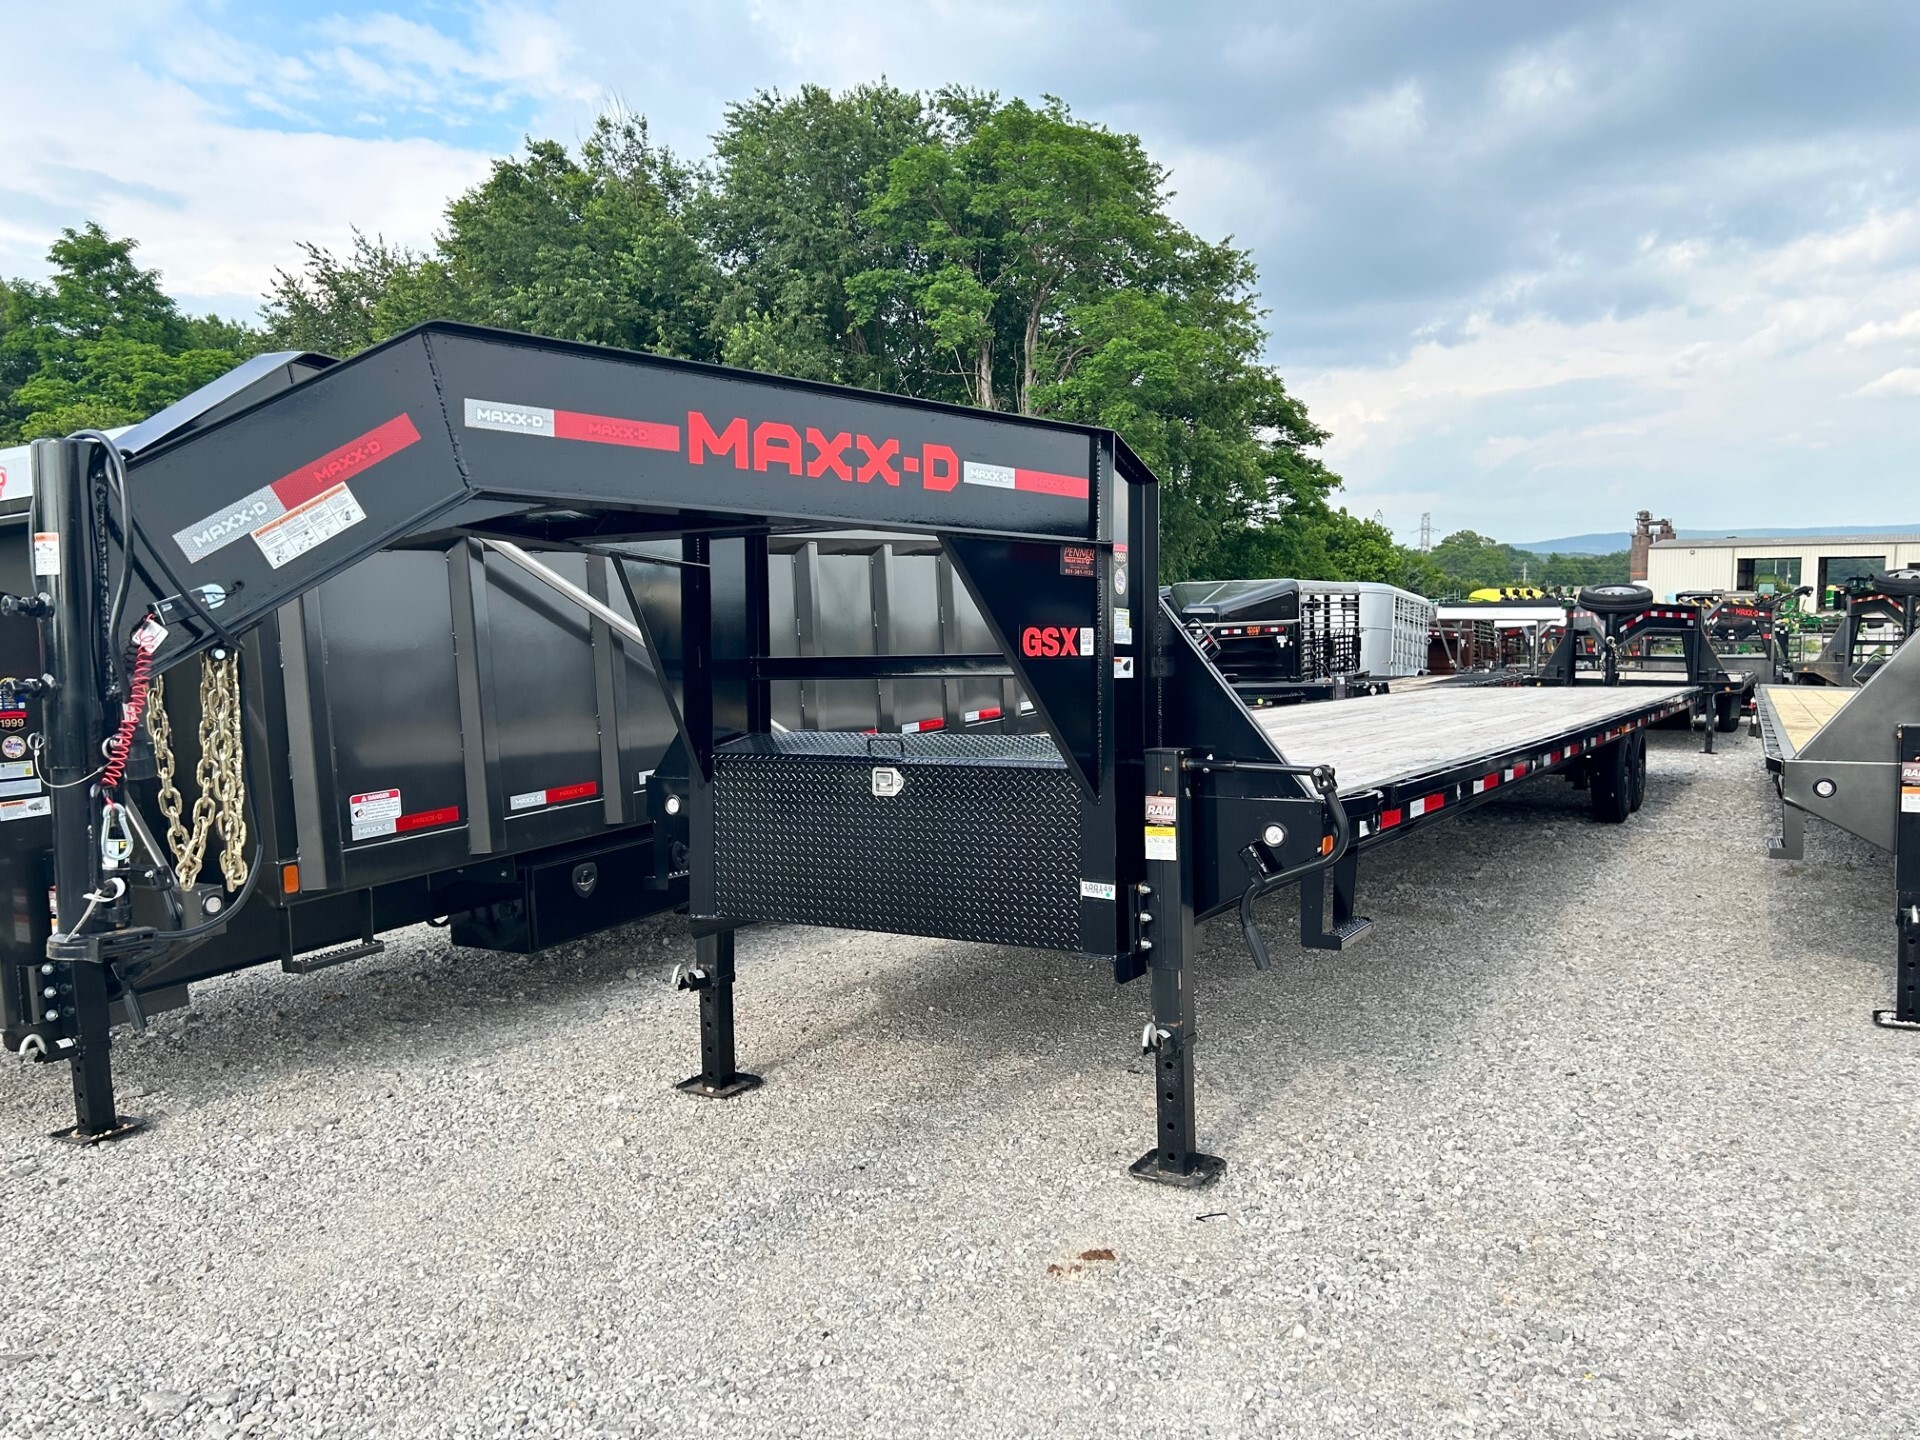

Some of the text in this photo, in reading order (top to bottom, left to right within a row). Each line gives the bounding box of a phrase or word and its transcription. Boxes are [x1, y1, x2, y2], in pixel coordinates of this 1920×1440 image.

[476, 408, 543, 427] MAXX-D
[688, 411, 959, 492] MAXX-D
[312, 440, 381, 484] MAXX-D
[192, 500, 268, 548] MAXX-D
[1064, 547, 1095, 559] PENNER
[1022, 626, 1079, 657] GSX
[1, 718, 24, 728] 1999
[1903, 768, 1920, 777] RA
[1147, 805, 1173, 815] RAM
